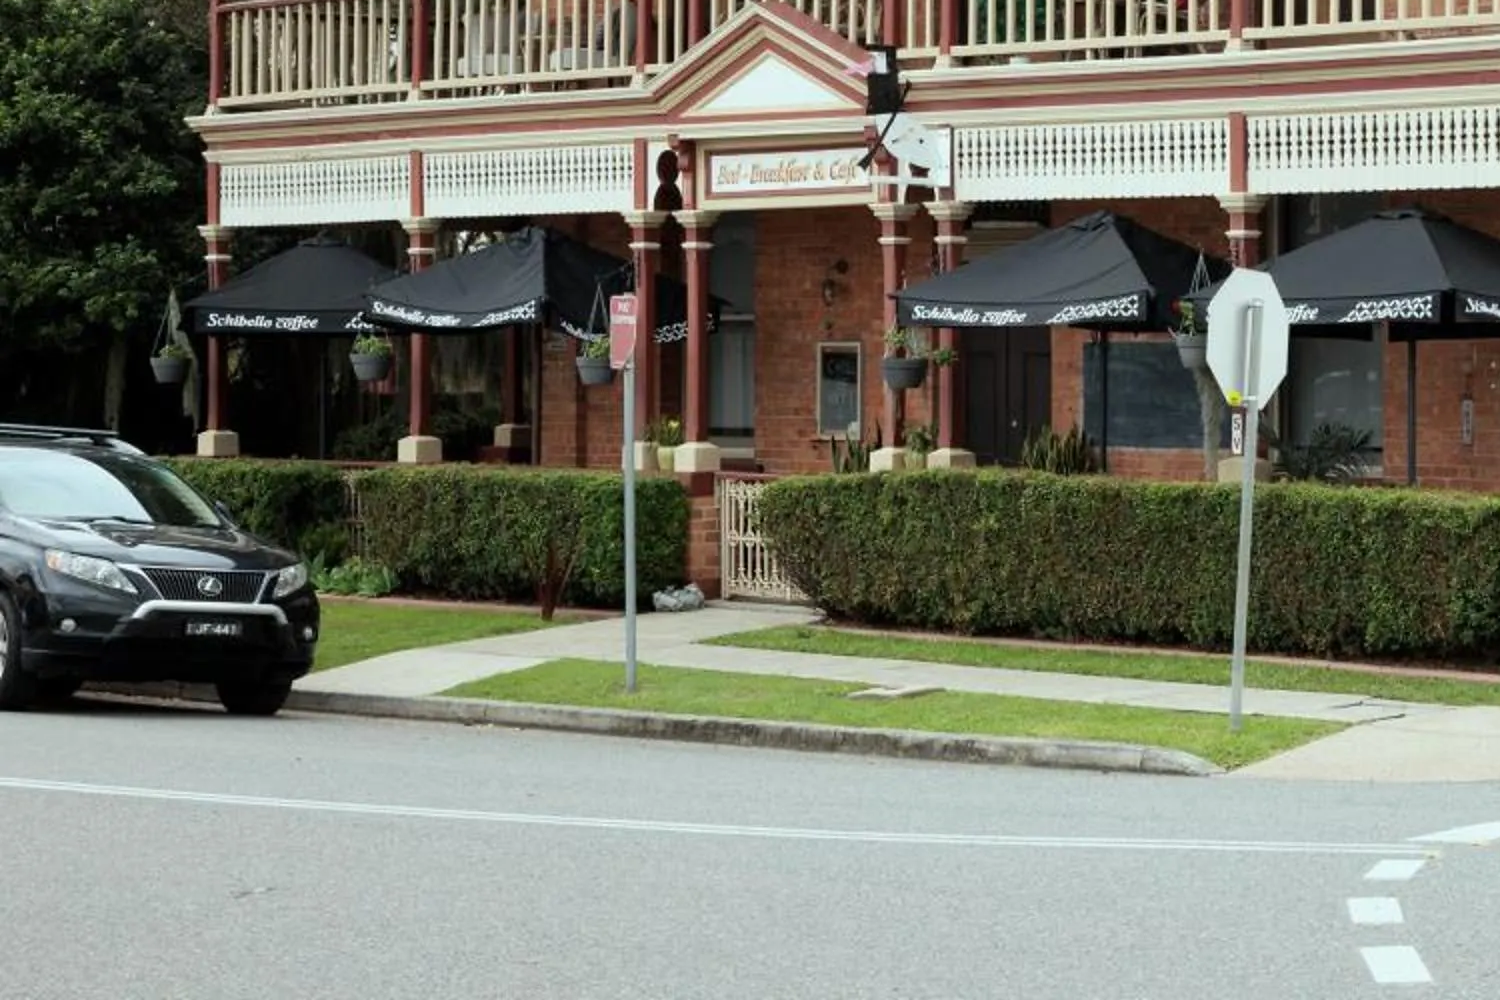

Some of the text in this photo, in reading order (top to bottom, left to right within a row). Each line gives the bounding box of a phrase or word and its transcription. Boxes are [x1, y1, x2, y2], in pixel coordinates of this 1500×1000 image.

[207, 313, 319, 331] Schibello coffee
[911, 305, 1027, 325] Schibello coffee
